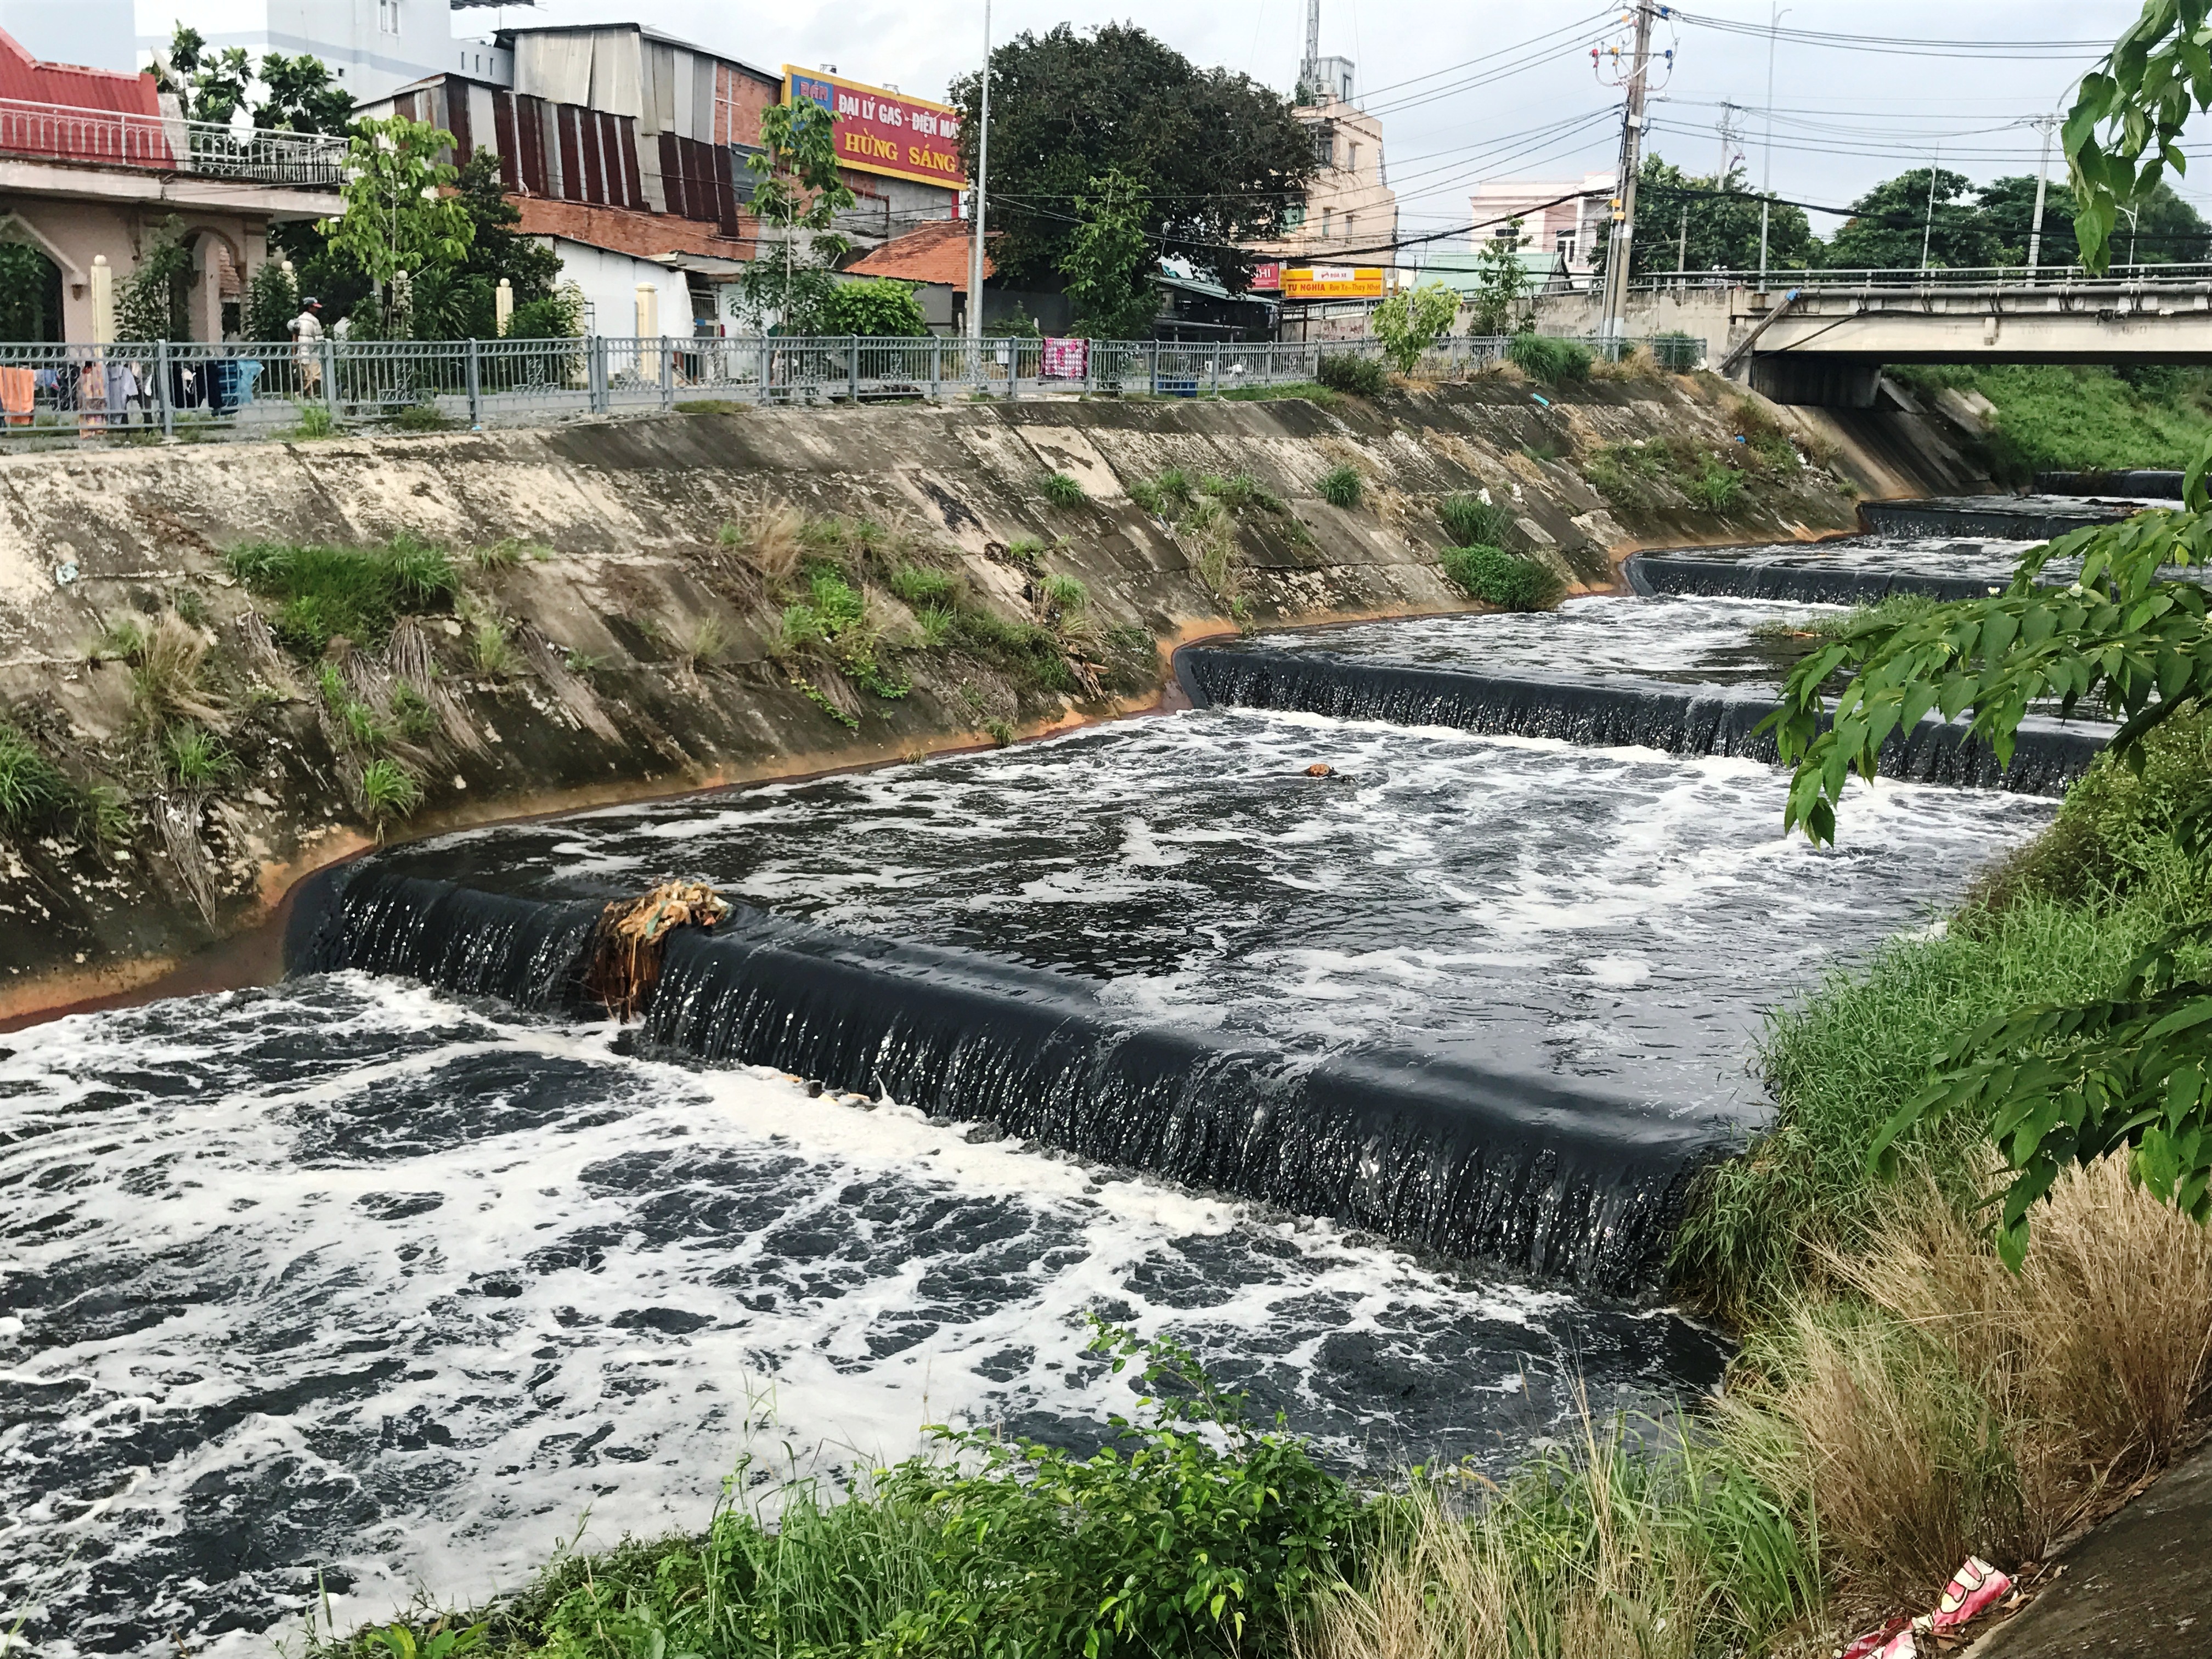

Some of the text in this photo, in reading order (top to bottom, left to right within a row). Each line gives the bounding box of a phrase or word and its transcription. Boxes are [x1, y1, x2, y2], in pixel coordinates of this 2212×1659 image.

[800, 81, 828, 101] BÁN
[838, 93, 859, 120] ĐẠI
[862, 96, 876, 120] LÝ
[879, 104, 902, 127] GAS
[912, 111, 937, 138] ĐIỆN
[909, 143, 956, 173] SÁNG
